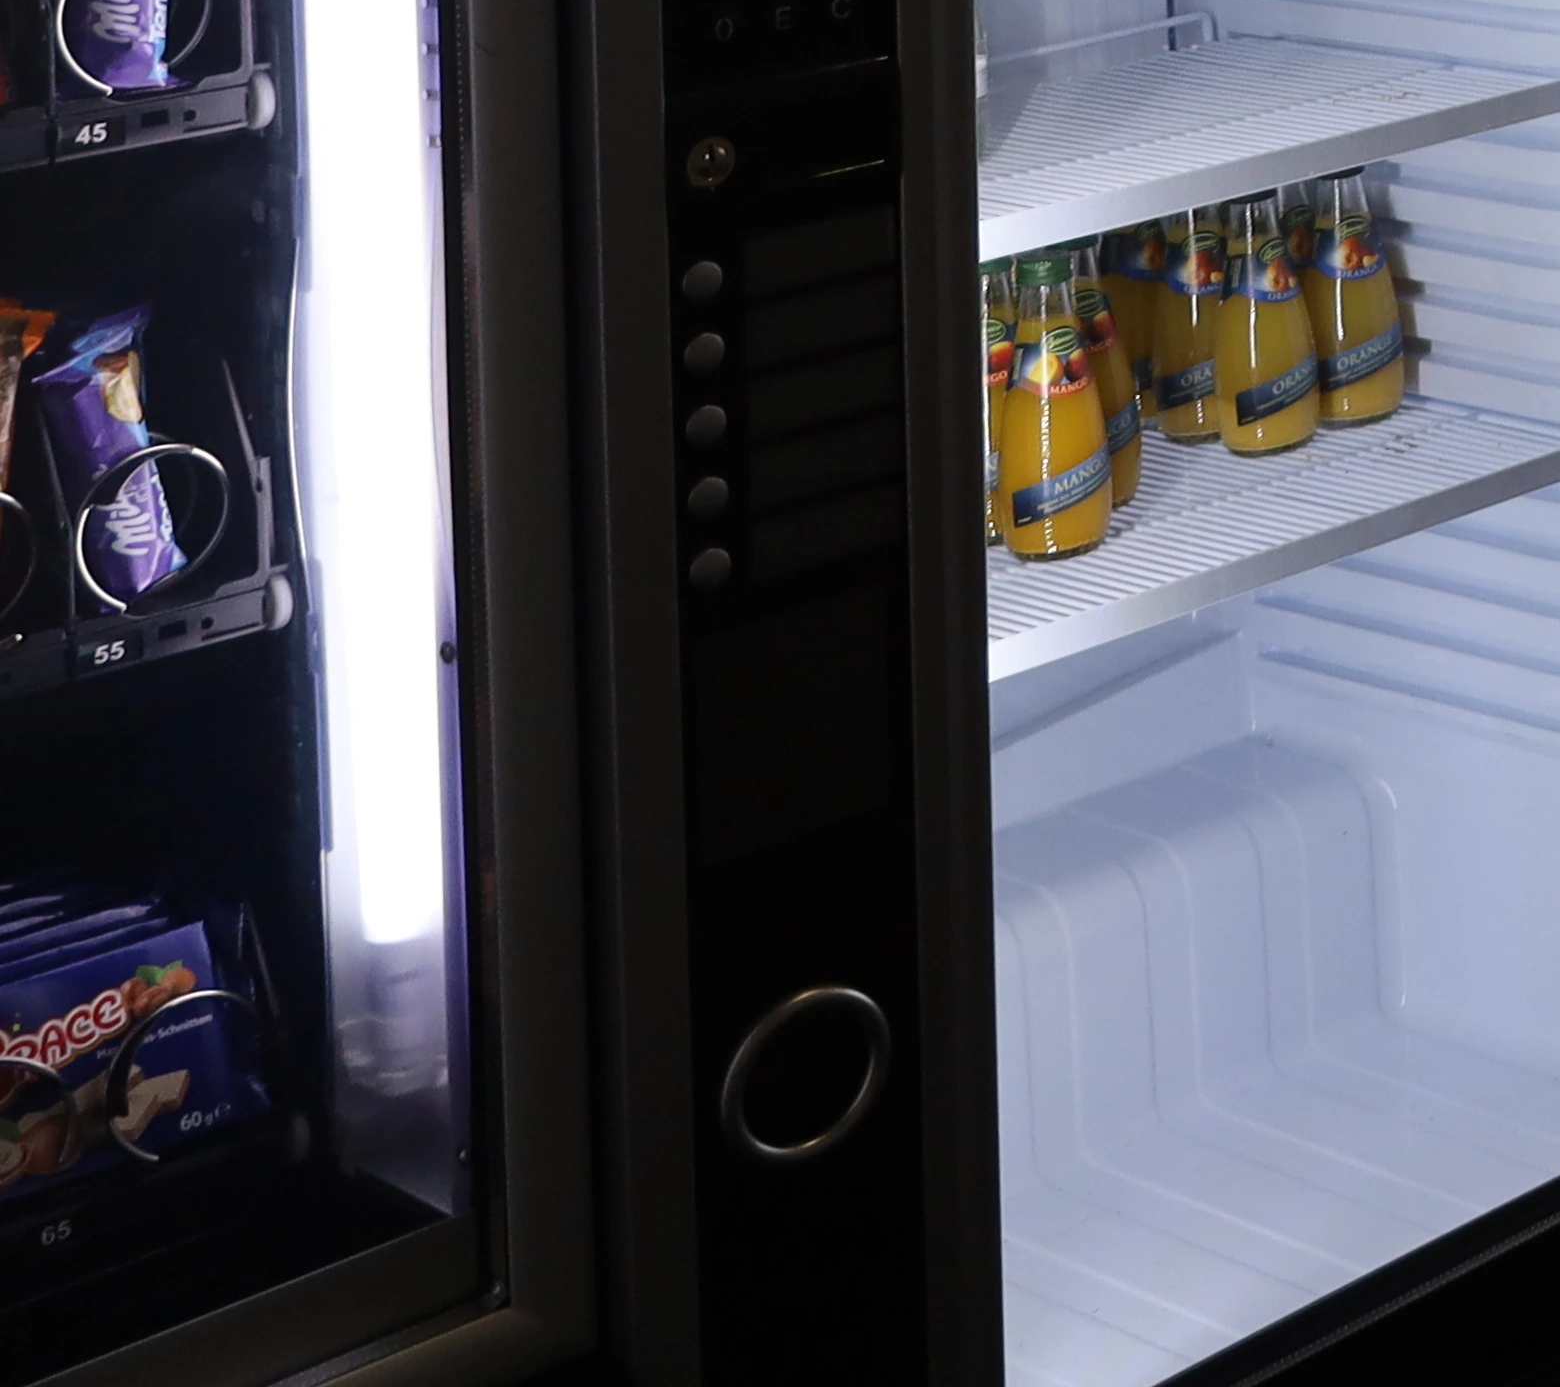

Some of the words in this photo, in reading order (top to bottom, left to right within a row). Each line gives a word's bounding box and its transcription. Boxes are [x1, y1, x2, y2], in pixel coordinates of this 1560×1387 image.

[714, 16, 735, 42] 0
[774, 6, 793, 30] E
[74, 121, 108, 146] 45
[1050, 376, 1090, 395] MANGO
[93, 640, 126, 665] 55
[178, 1109, 203, 1133] 60
[39, 1219, 73, 1247] 65
